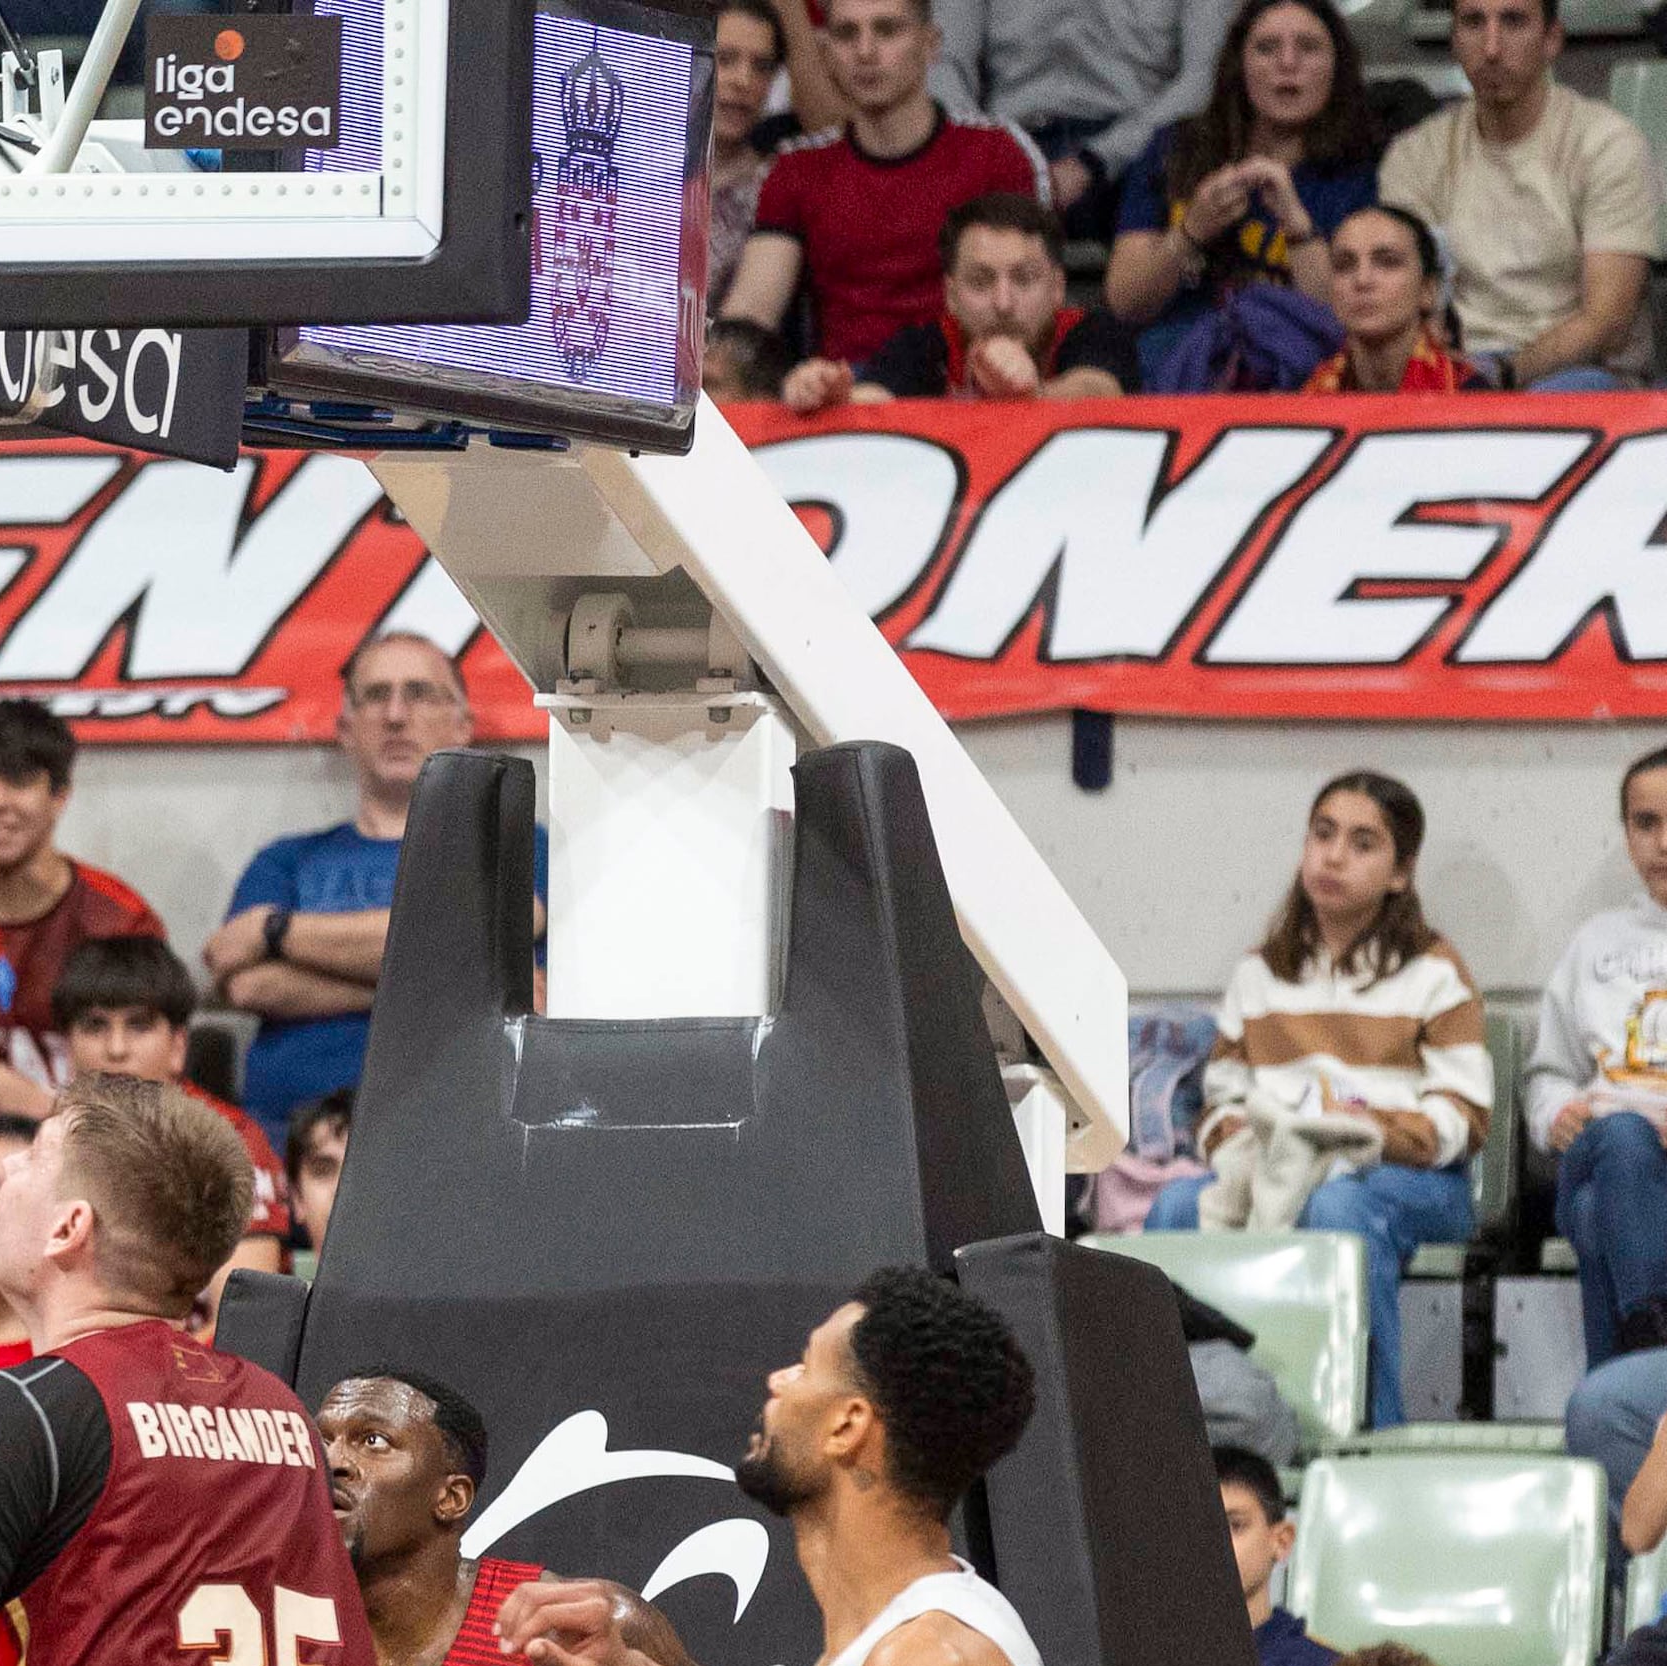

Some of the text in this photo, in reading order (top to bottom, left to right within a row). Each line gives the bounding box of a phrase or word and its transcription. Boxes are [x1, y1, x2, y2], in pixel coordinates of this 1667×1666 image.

[154, 55, 236, 97] liga
[154, 97, 332, 138] endesa
[125, 1400, 317, 1470] BIRGANDER
